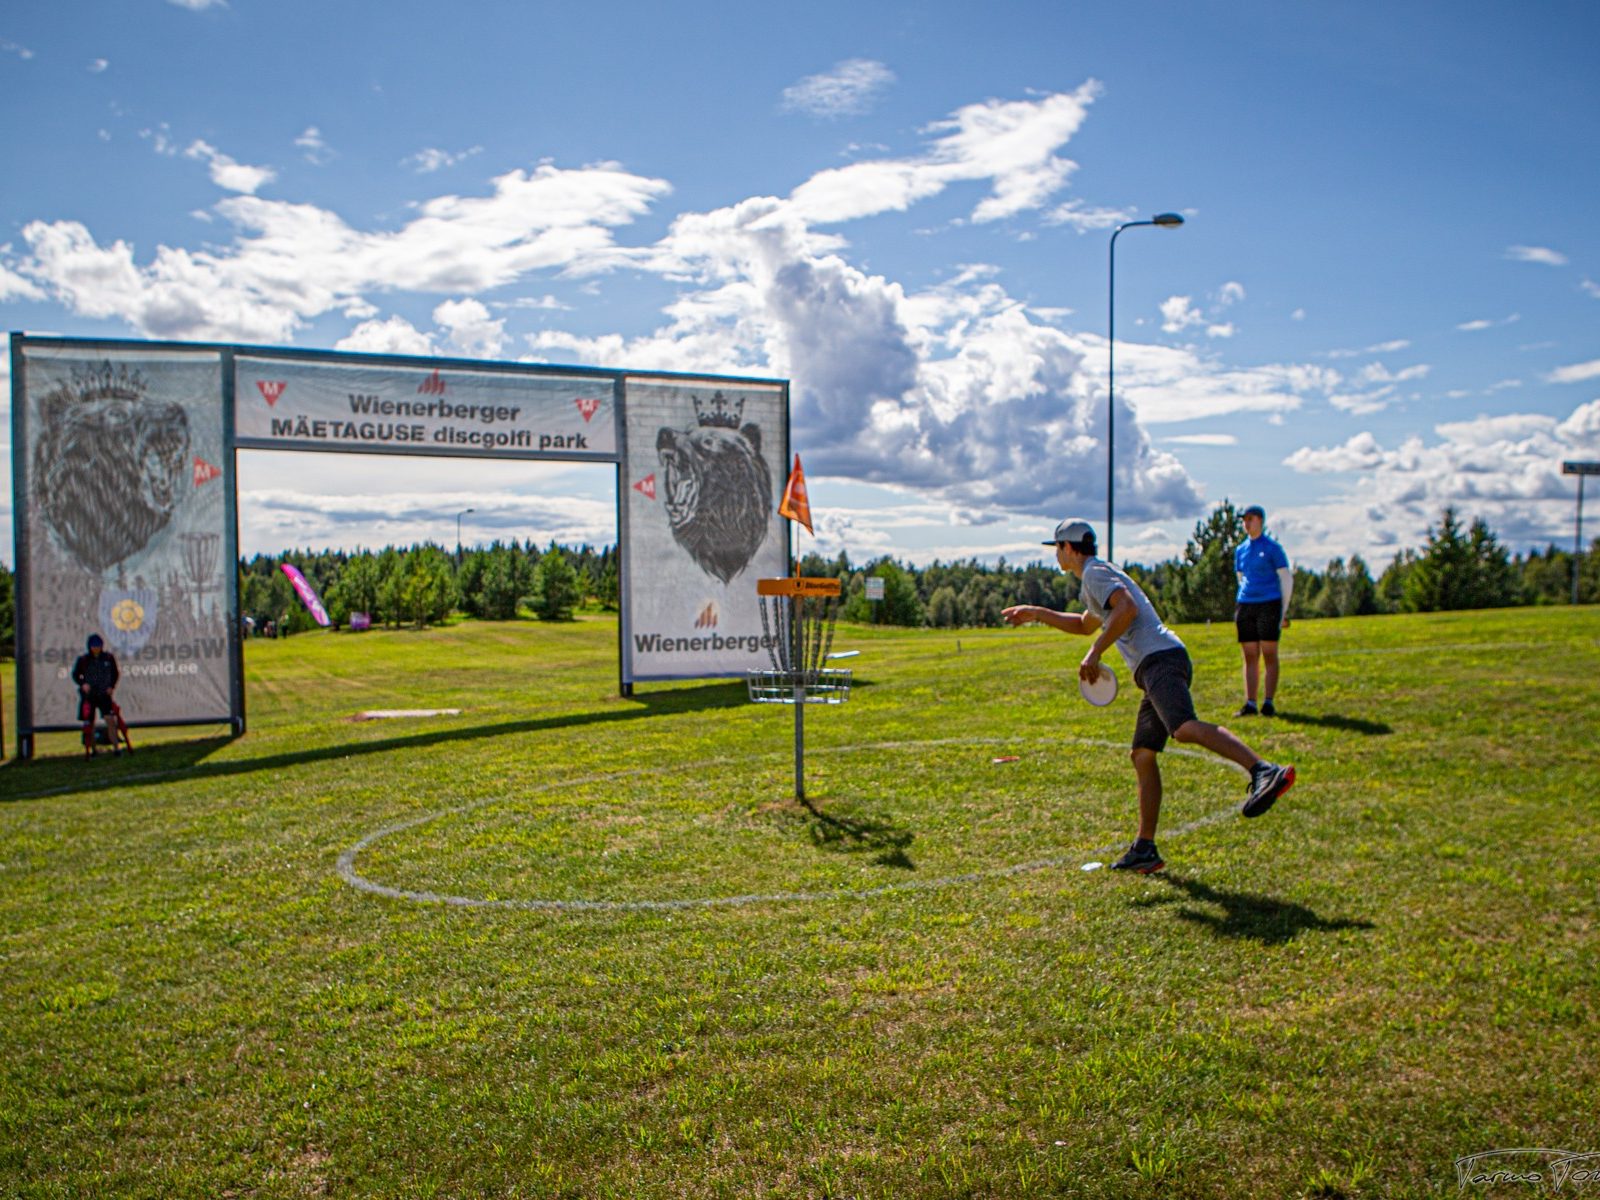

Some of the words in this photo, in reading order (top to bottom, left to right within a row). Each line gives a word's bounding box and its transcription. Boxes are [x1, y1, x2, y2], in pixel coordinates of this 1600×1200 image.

[264, 381, 278, 395] M
[348, 393, 521, 424] Wienerberger
[271, 415, 425, 442] MÄETAGUSE
[434, 427, 531, 449] discgolfi
[539, 432, 588, 451] park
